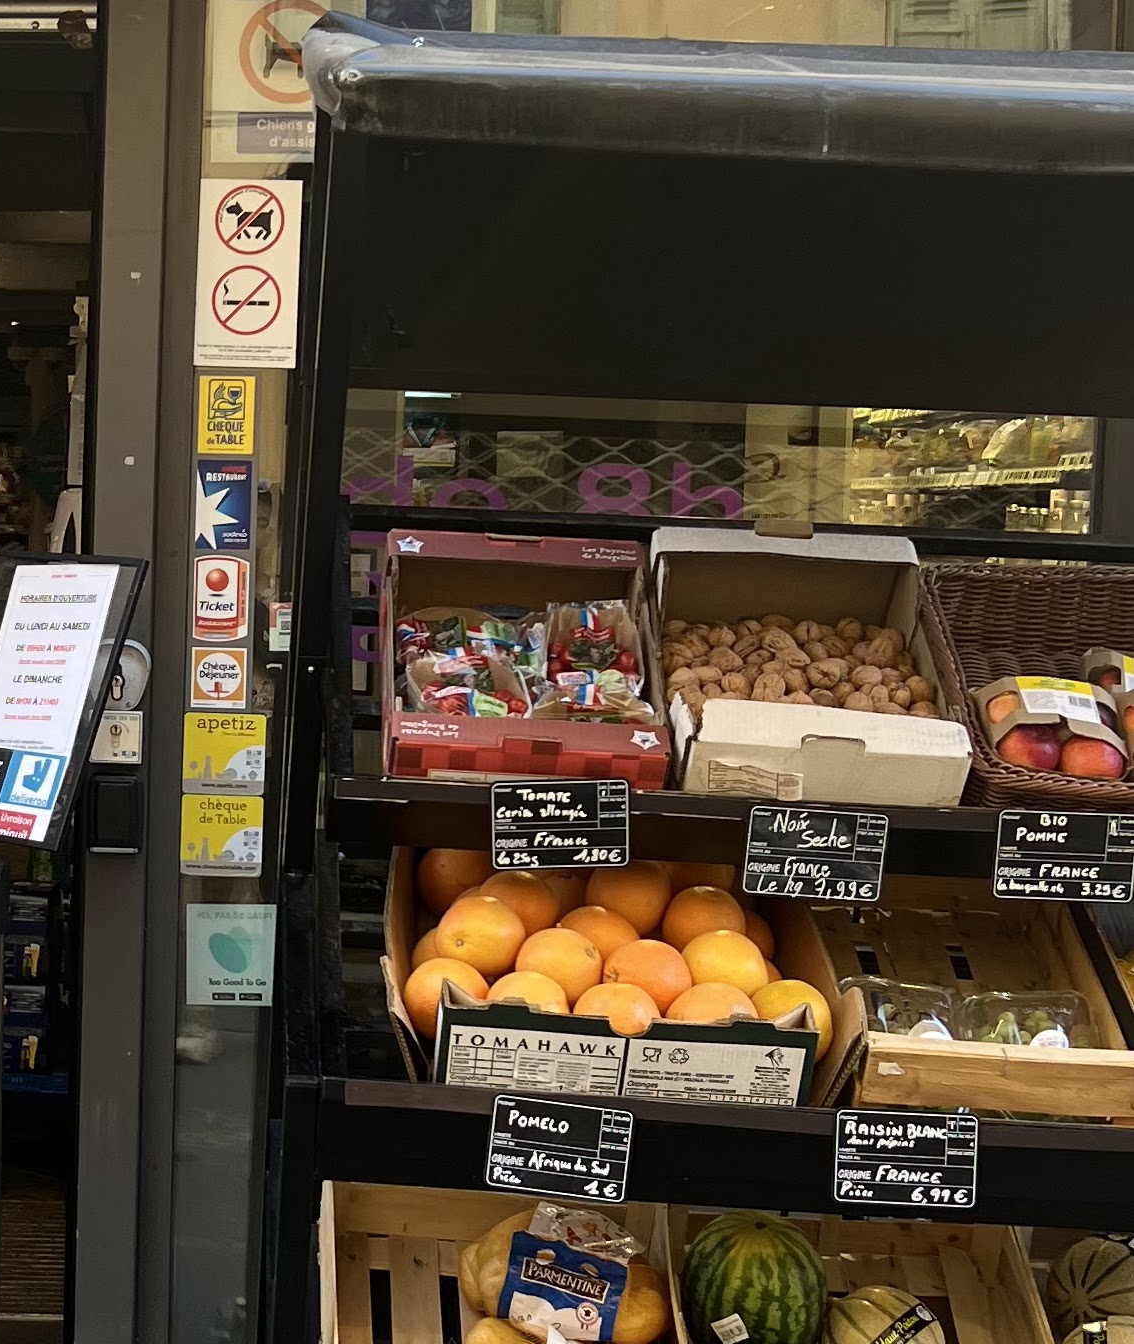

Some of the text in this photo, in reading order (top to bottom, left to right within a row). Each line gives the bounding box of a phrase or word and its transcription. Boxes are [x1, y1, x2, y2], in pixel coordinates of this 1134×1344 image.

[257, 119, 303, 131] Chiens
[215, 434, 245, 445] TABLE
[199, 601, 235, 612] Ticket
[14, 622, 91, 630] DU LUNDI AU SAMEDI
[15, 644, 25, 652] DE
[202, 661, 237, 671] Chèque
[12, 675, 63, 684] LE DIMANCHE
[199, 670, 240, 680] Déjeuner
[5, 697, 15, 705] DE
[197, 716, 257, 733] apetiz
[10, 792, 47, 807] deliveroo
[516, 788, 571, 803] TOMATE
[199, 797, 247, 814] chèque
[0, 812, 33, 826] Livraison
[199, 812, 247, 825] de Table
[773, 812, 811, 834] Noix
[1040, 814, 1068, 827] BIO
[1015, 827, 1069, 844] POMME
[747, 857, 831, 878] ORIGINE France
[1039, 863, 1100, 879] FRANCE
[757, 875, 778, 893] Le
[208, 977, 267, 987] Too Good To Go
[452, 1033, 617, 1057] TOMAHAWK
[626, 1080, 659, 1089] Oranges
[508, 1110, 570, 1134] POMELO
[844, 1120, 904, 1137] RAISIN
[906, 1124, 949, 1140] BLANC
[573, 1158, 588, 1173] du
[590, 1161, 610, 1177] Sud
[875, 1164, 943, 1184] FRANCE
[527, 1262, 603, 1296] PARMENTINE
